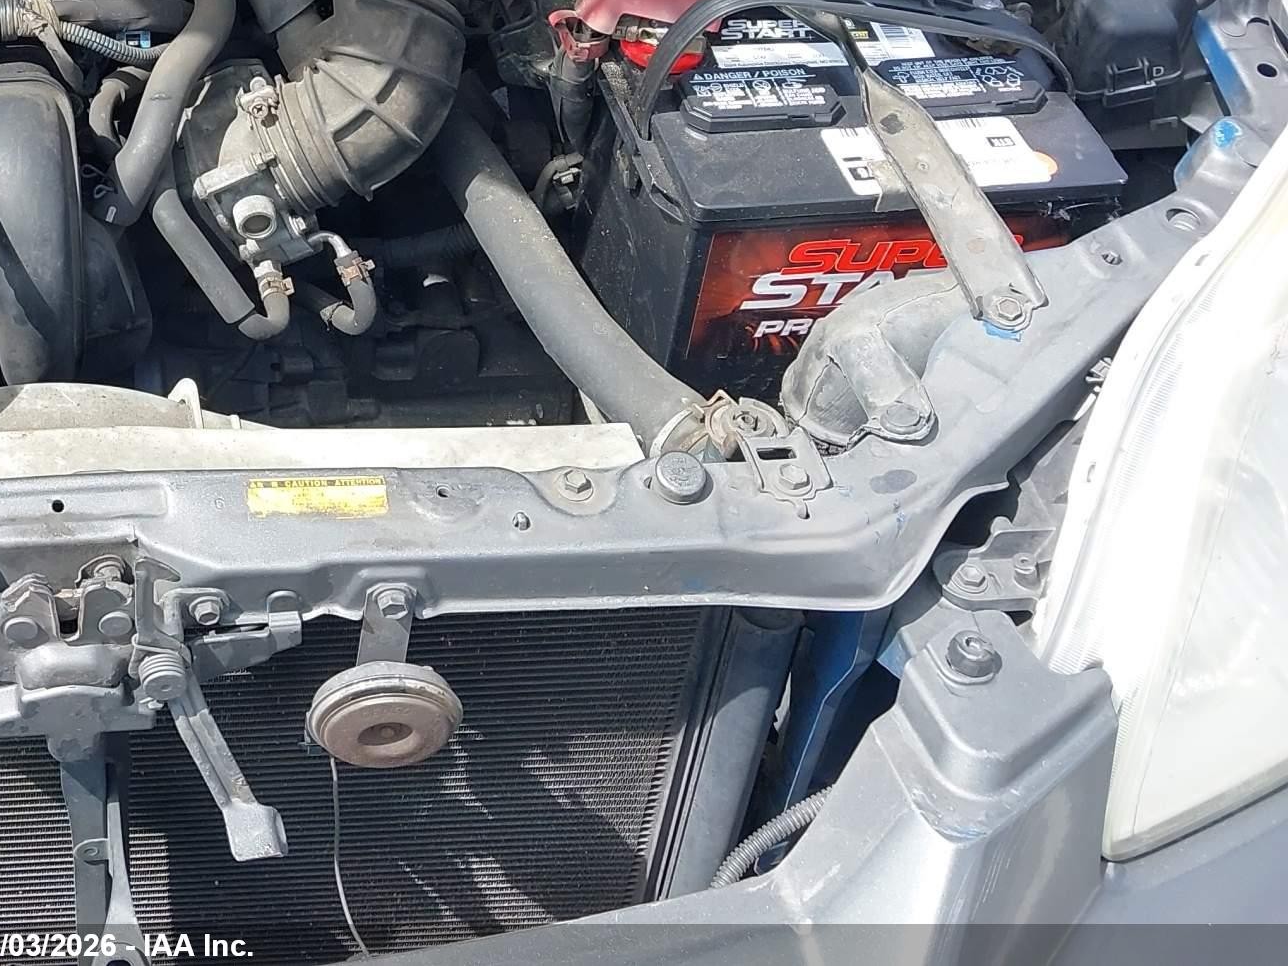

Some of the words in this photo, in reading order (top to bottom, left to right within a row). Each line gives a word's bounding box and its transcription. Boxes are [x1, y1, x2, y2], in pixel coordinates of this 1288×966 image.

[727, 19, 810, 29] SUPER
[721, 28, 808, 40] START
[706, 71, 751, 80] DANGER
[762, 68, 806, 77] POISON
[285, 479, 328, 488] CAUTION
[335, 478, 382, 487] ATTENTION
